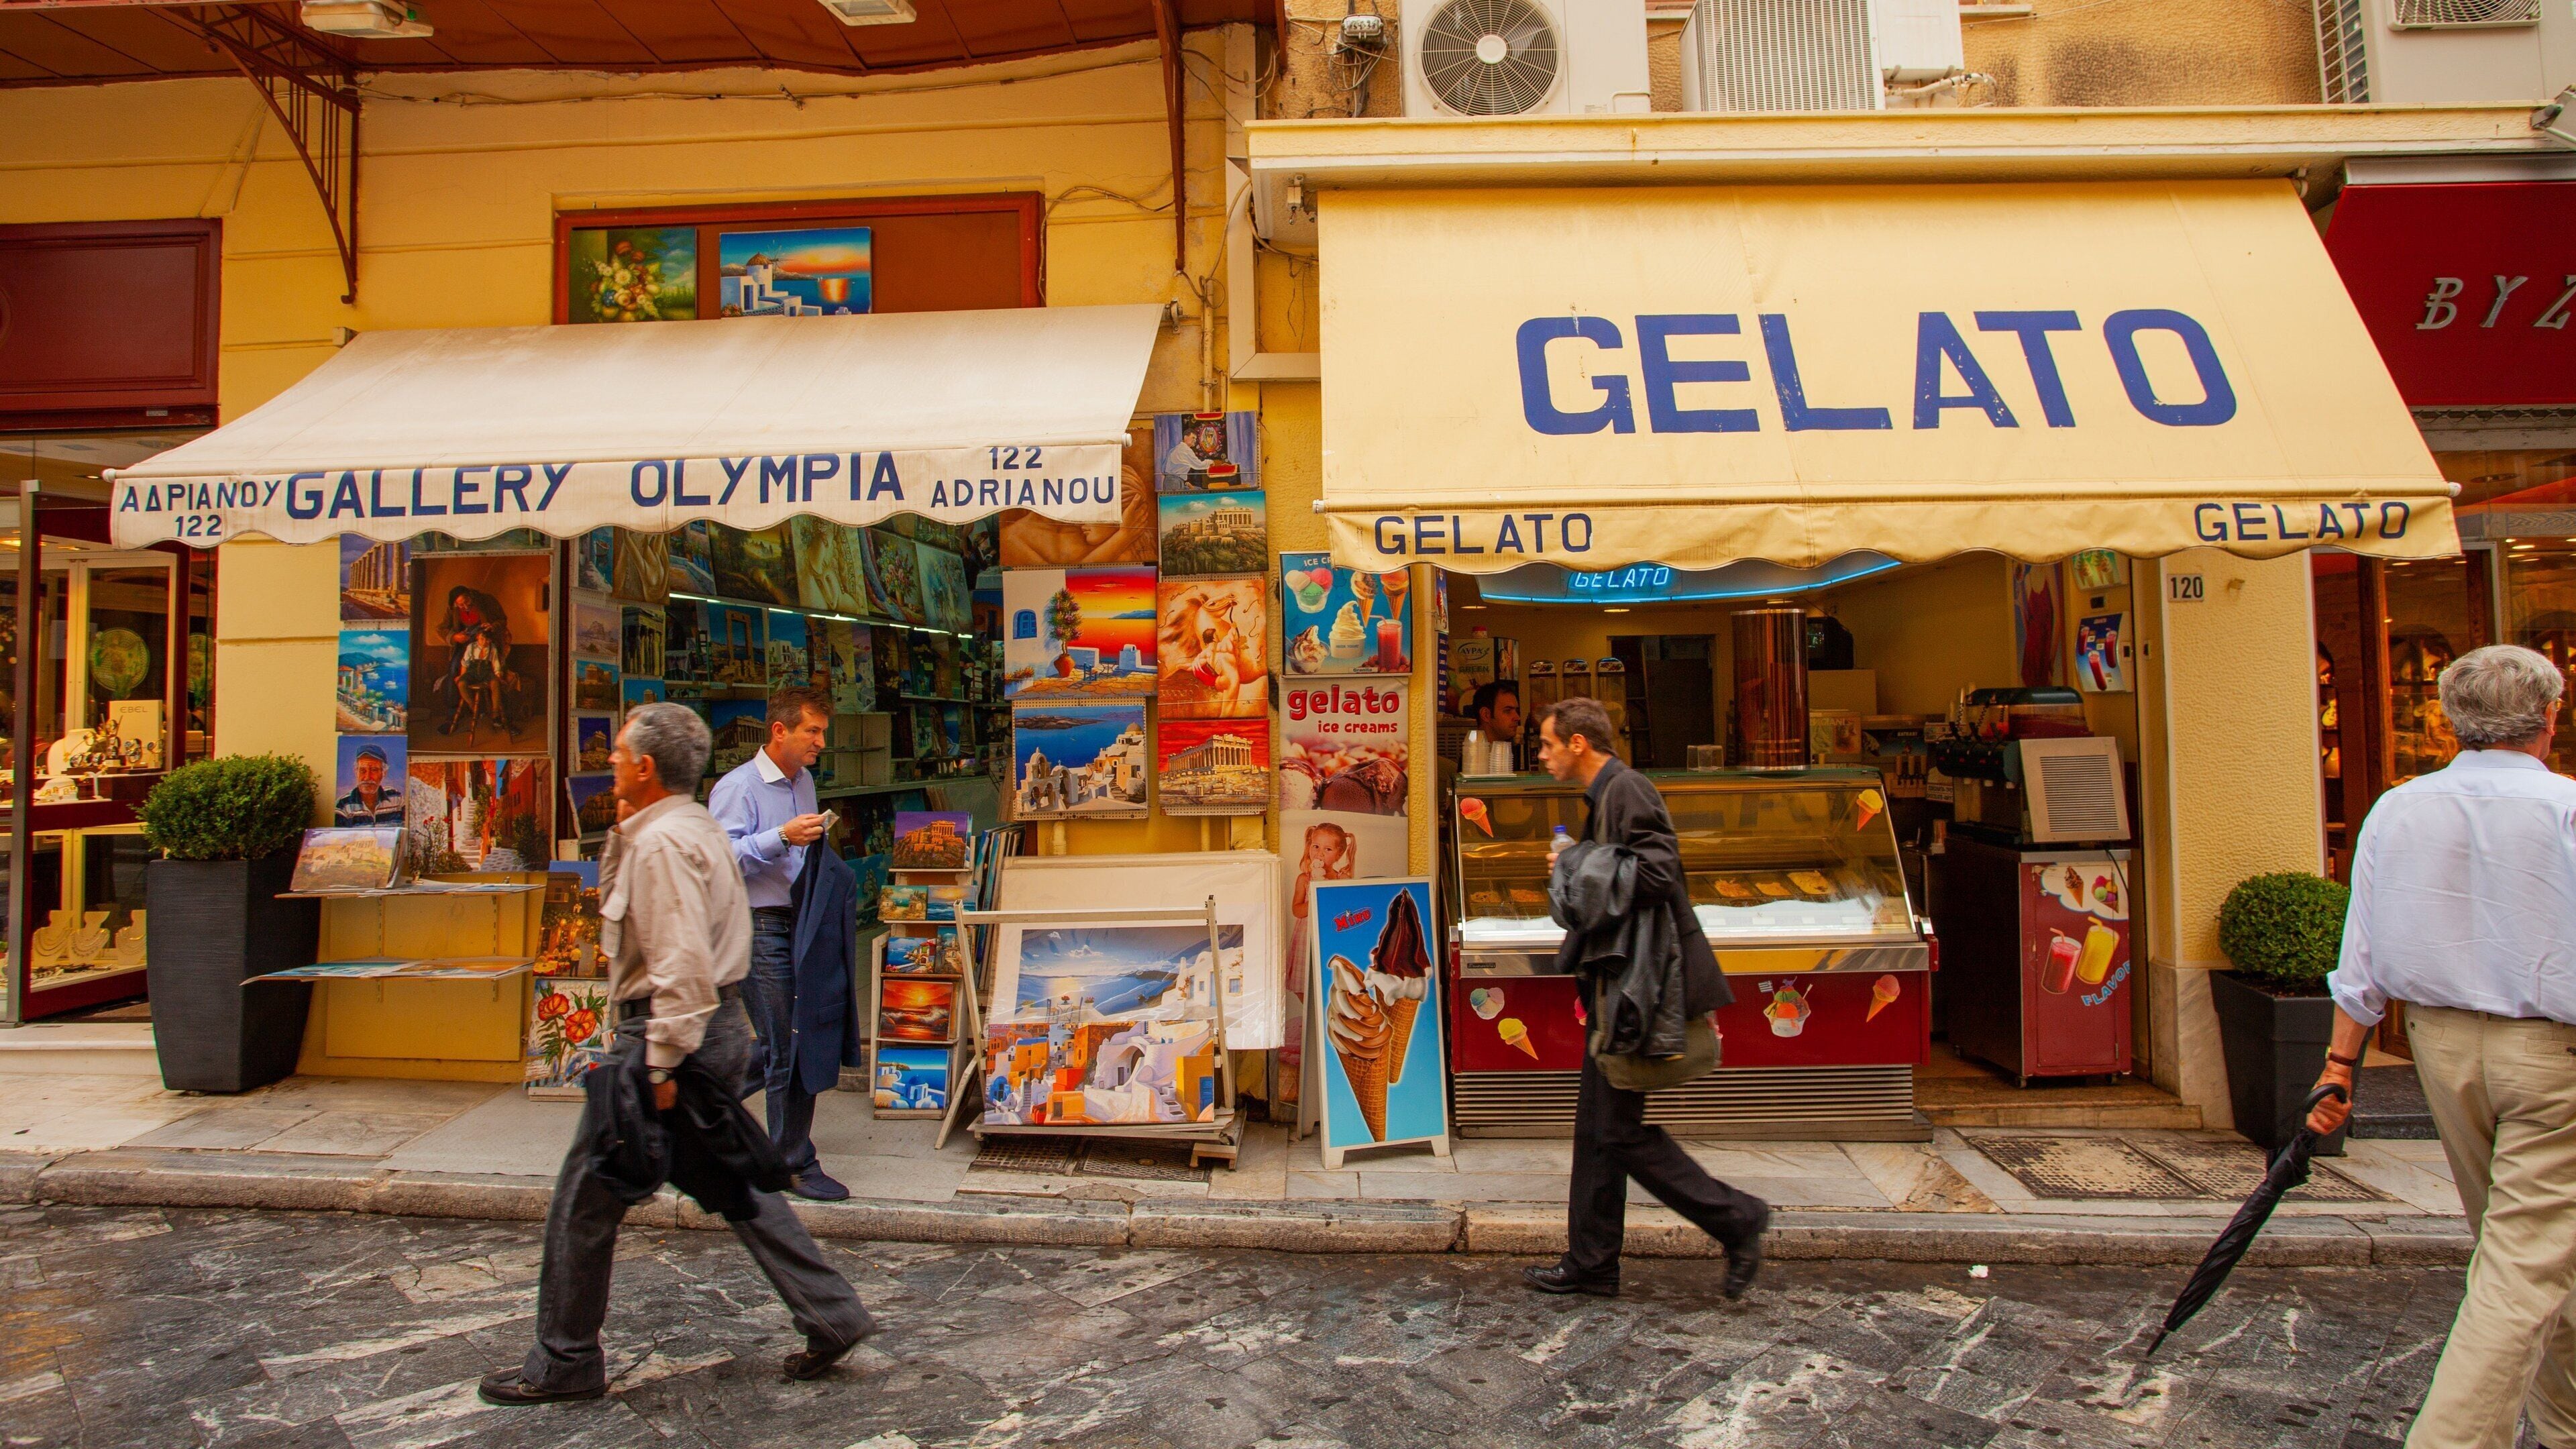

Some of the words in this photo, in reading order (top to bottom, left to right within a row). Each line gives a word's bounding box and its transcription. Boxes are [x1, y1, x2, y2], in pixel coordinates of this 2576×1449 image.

[1515, 309, 2237, 436] GELATO
[988, 445, 1042, 470] 122
[286, 462, 576, 519] GALLERY
[631, 451, 904, 507] OLYMPIA
[930, 476, 1114, 508] ADRIANOU
[175, 515, 222, 537] 122
[1375, 513, 1593, 555] GELATO
[2194, 501, 2410, 541] GELATO
[1303, 558, 1319, 566] ICE
[1574, 567, 1670, 588] GELATO
[2170, 576, 2203, 598] 120
[1288, 684, 1400, 720] gelato
[1318, 720, 1339, 733] ice
[1344, 722, 1397, 733] creams
